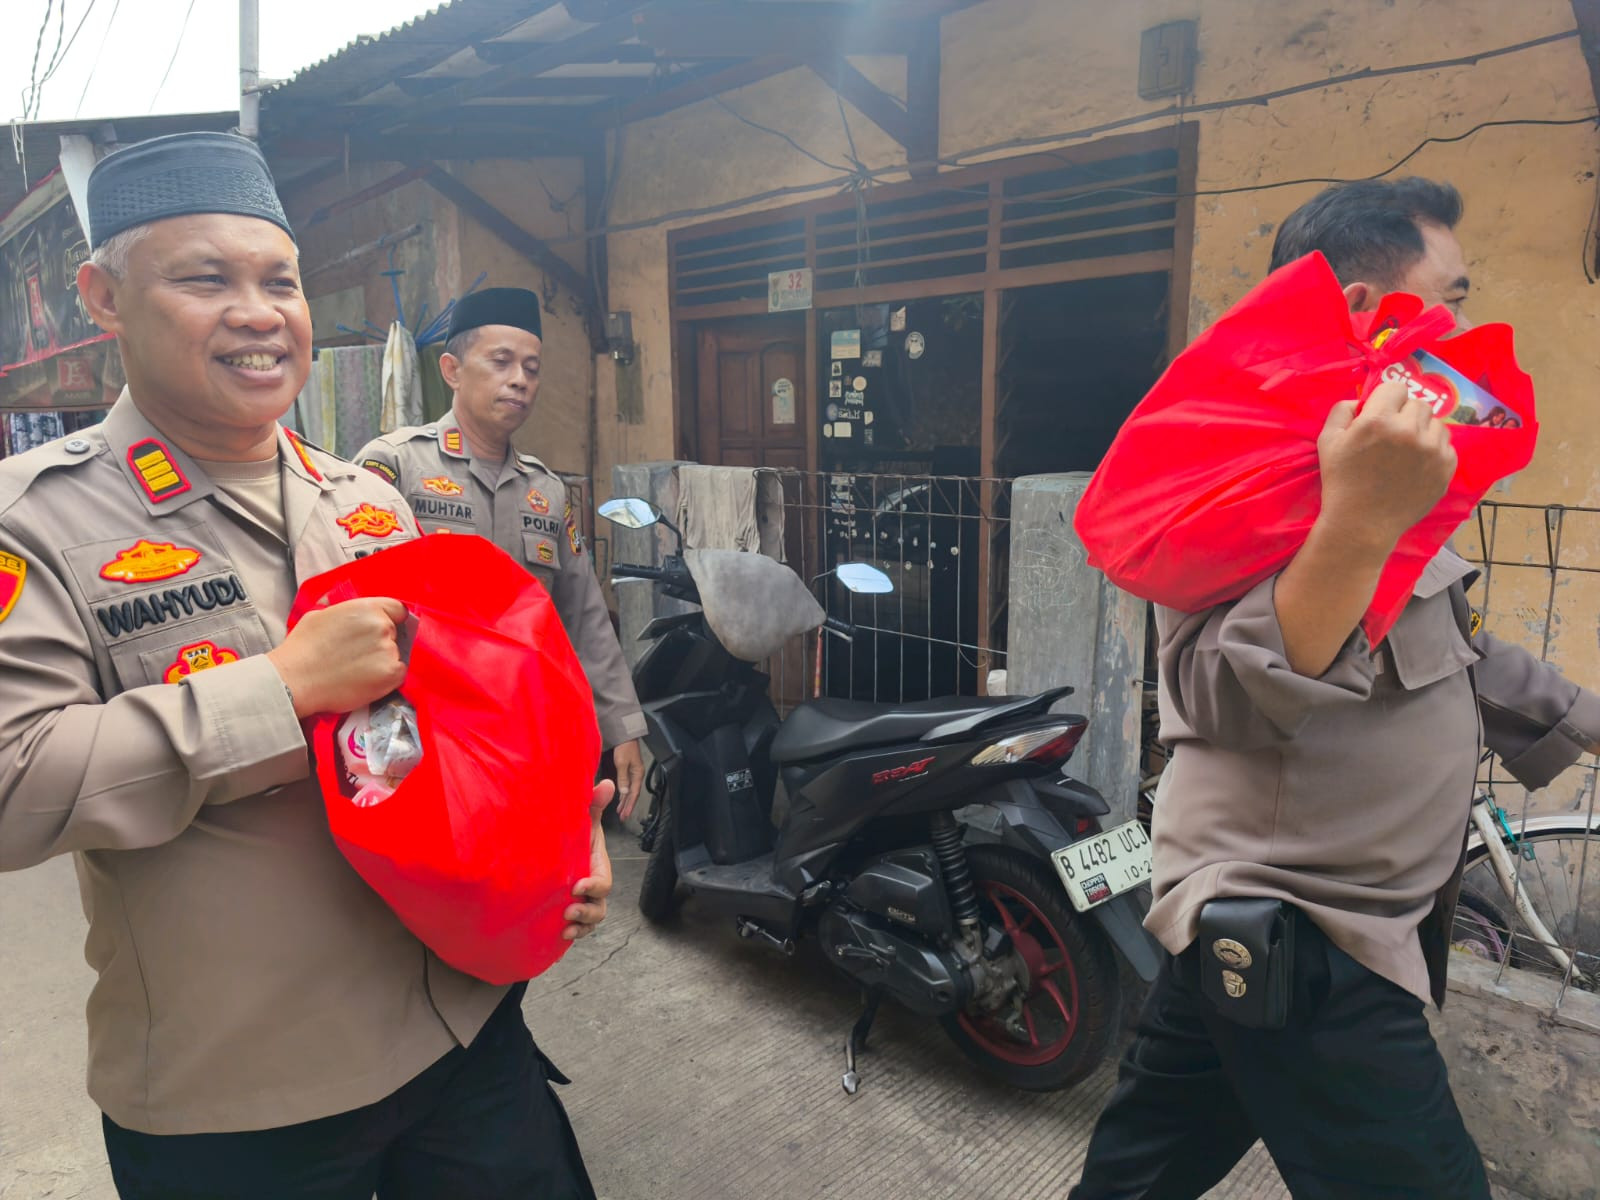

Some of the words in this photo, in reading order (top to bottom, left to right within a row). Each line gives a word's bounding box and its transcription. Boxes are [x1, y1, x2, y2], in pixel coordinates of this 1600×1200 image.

[788, 271, 802, 289] 32
[414, 499, 472, 520] MUHTAR
[523, 516, 559, 535] POLRI
[97, 574, 246, 638] WAHYUDI
[1060, 855, 1075, 879] B
[1079, 838, 1117, 872] 4482
[1117, 824, 1148, 853] UCJ
